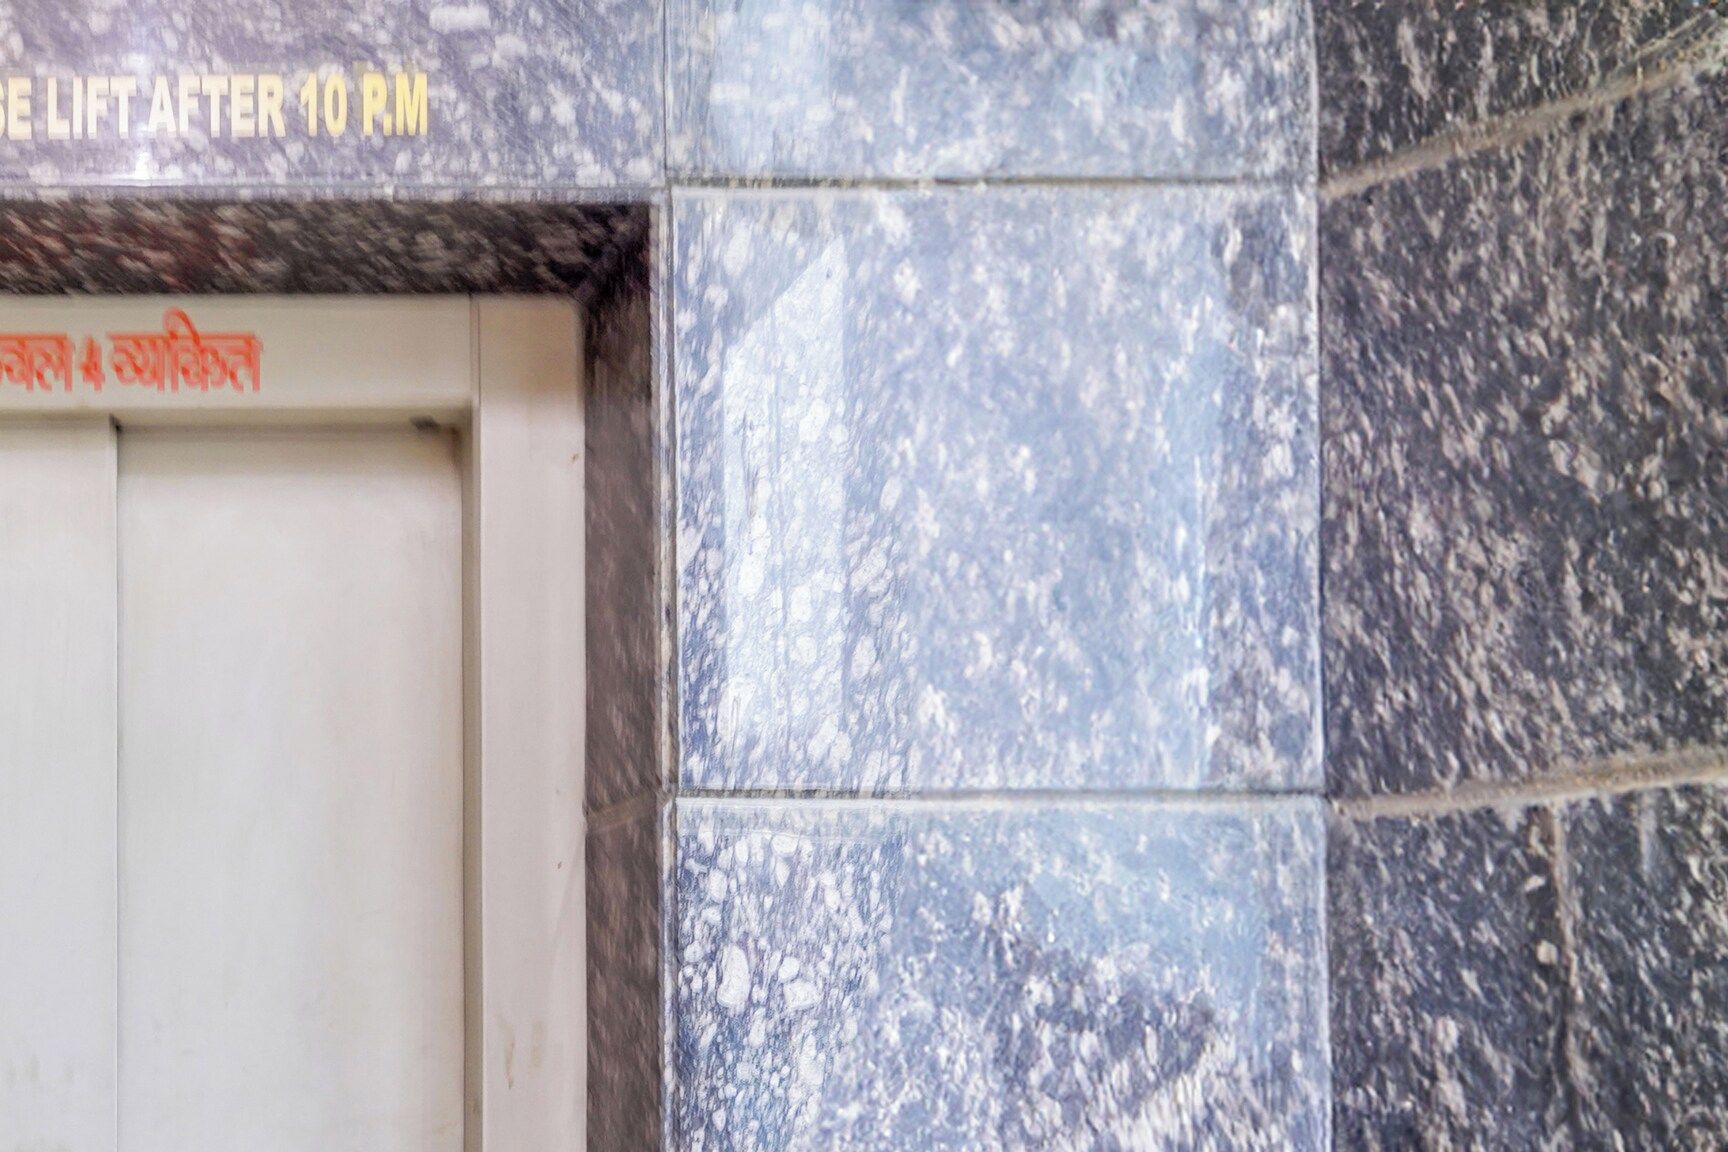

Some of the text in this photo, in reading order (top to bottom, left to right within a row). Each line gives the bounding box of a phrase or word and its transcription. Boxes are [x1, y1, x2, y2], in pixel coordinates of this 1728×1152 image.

[47, 74, 137, 140] LIFT
[147, 73, 286, 138] AFTER
[299, 72, 348, 138] 10
